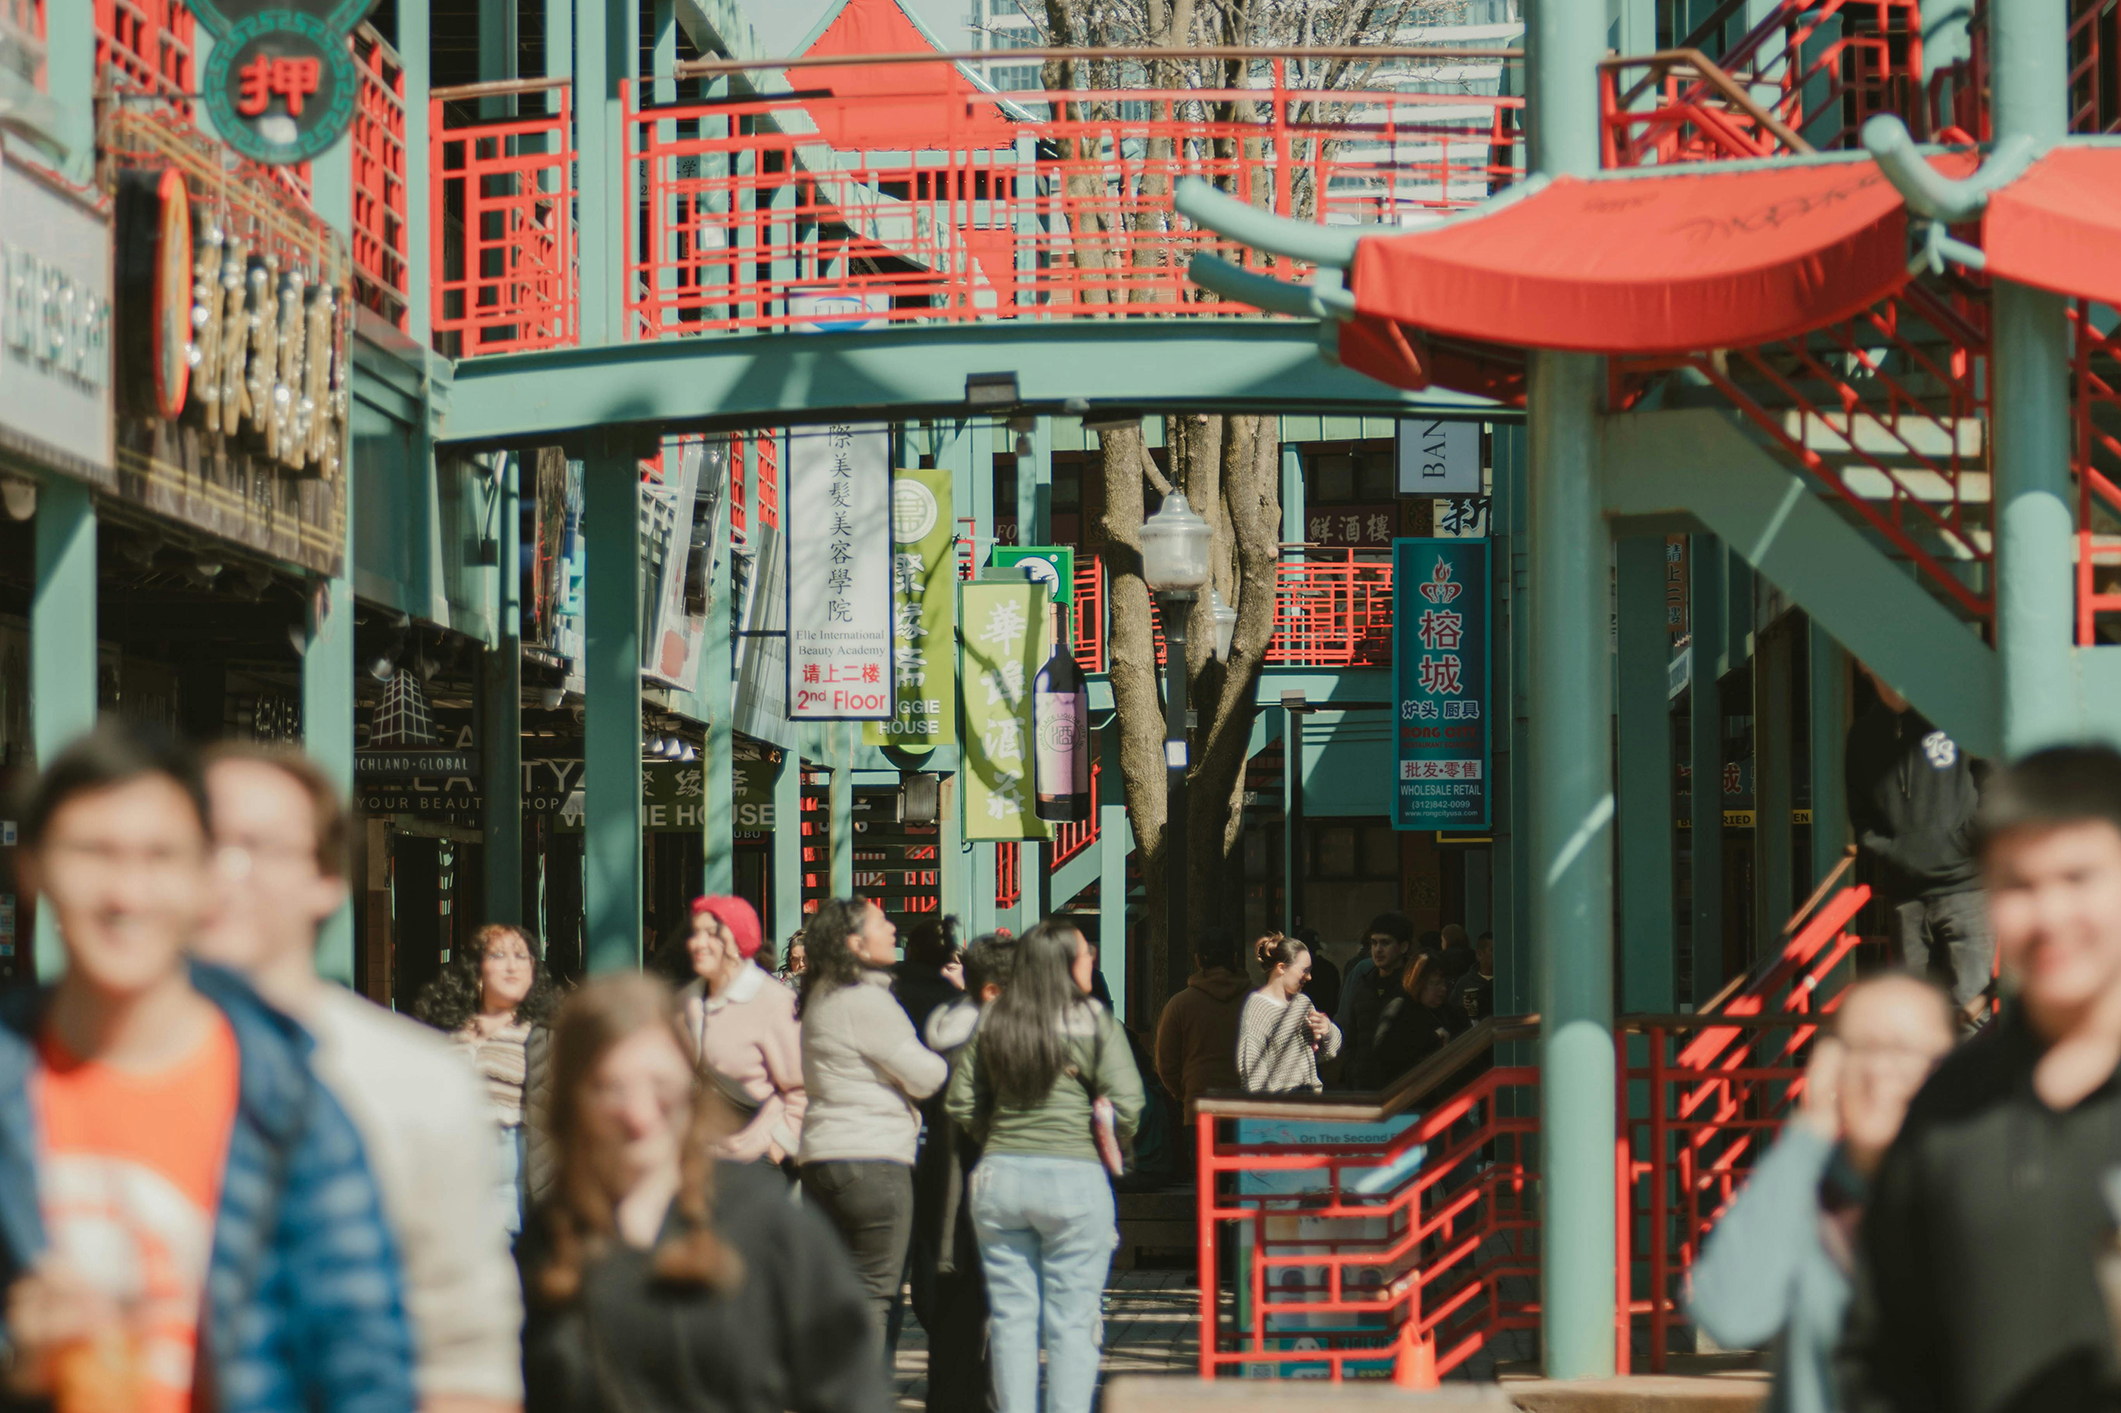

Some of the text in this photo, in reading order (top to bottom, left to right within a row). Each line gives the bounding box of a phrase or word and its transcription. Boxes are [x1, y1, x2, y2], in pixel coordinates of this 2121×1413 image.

[238, 54, 320, 117] 押
[796, 629, 885, 640] Elle International
[798, 645, 885, 658] Beauty Academy
[1418, 609, 1463, 694] 榕城
[802, 663, 880, 684] 请上二楼
[797, 689, 886, 710] 2nd Floor
[1402, 700, 1479, 719] 炉头 厨具
[878, 720, 939, 735] HOUSE
[1400, 784, 1482, 796] WHOLESALE RETAIL
[357, 797, 409, 810] YOUR
[1412, 800, 1471, 810] (312)842-0099
[1300, 1133, 1316, 1144] On
[1319, 1133, 1341, 1144] The
[1343, 1133, 1388, 1144] Second
